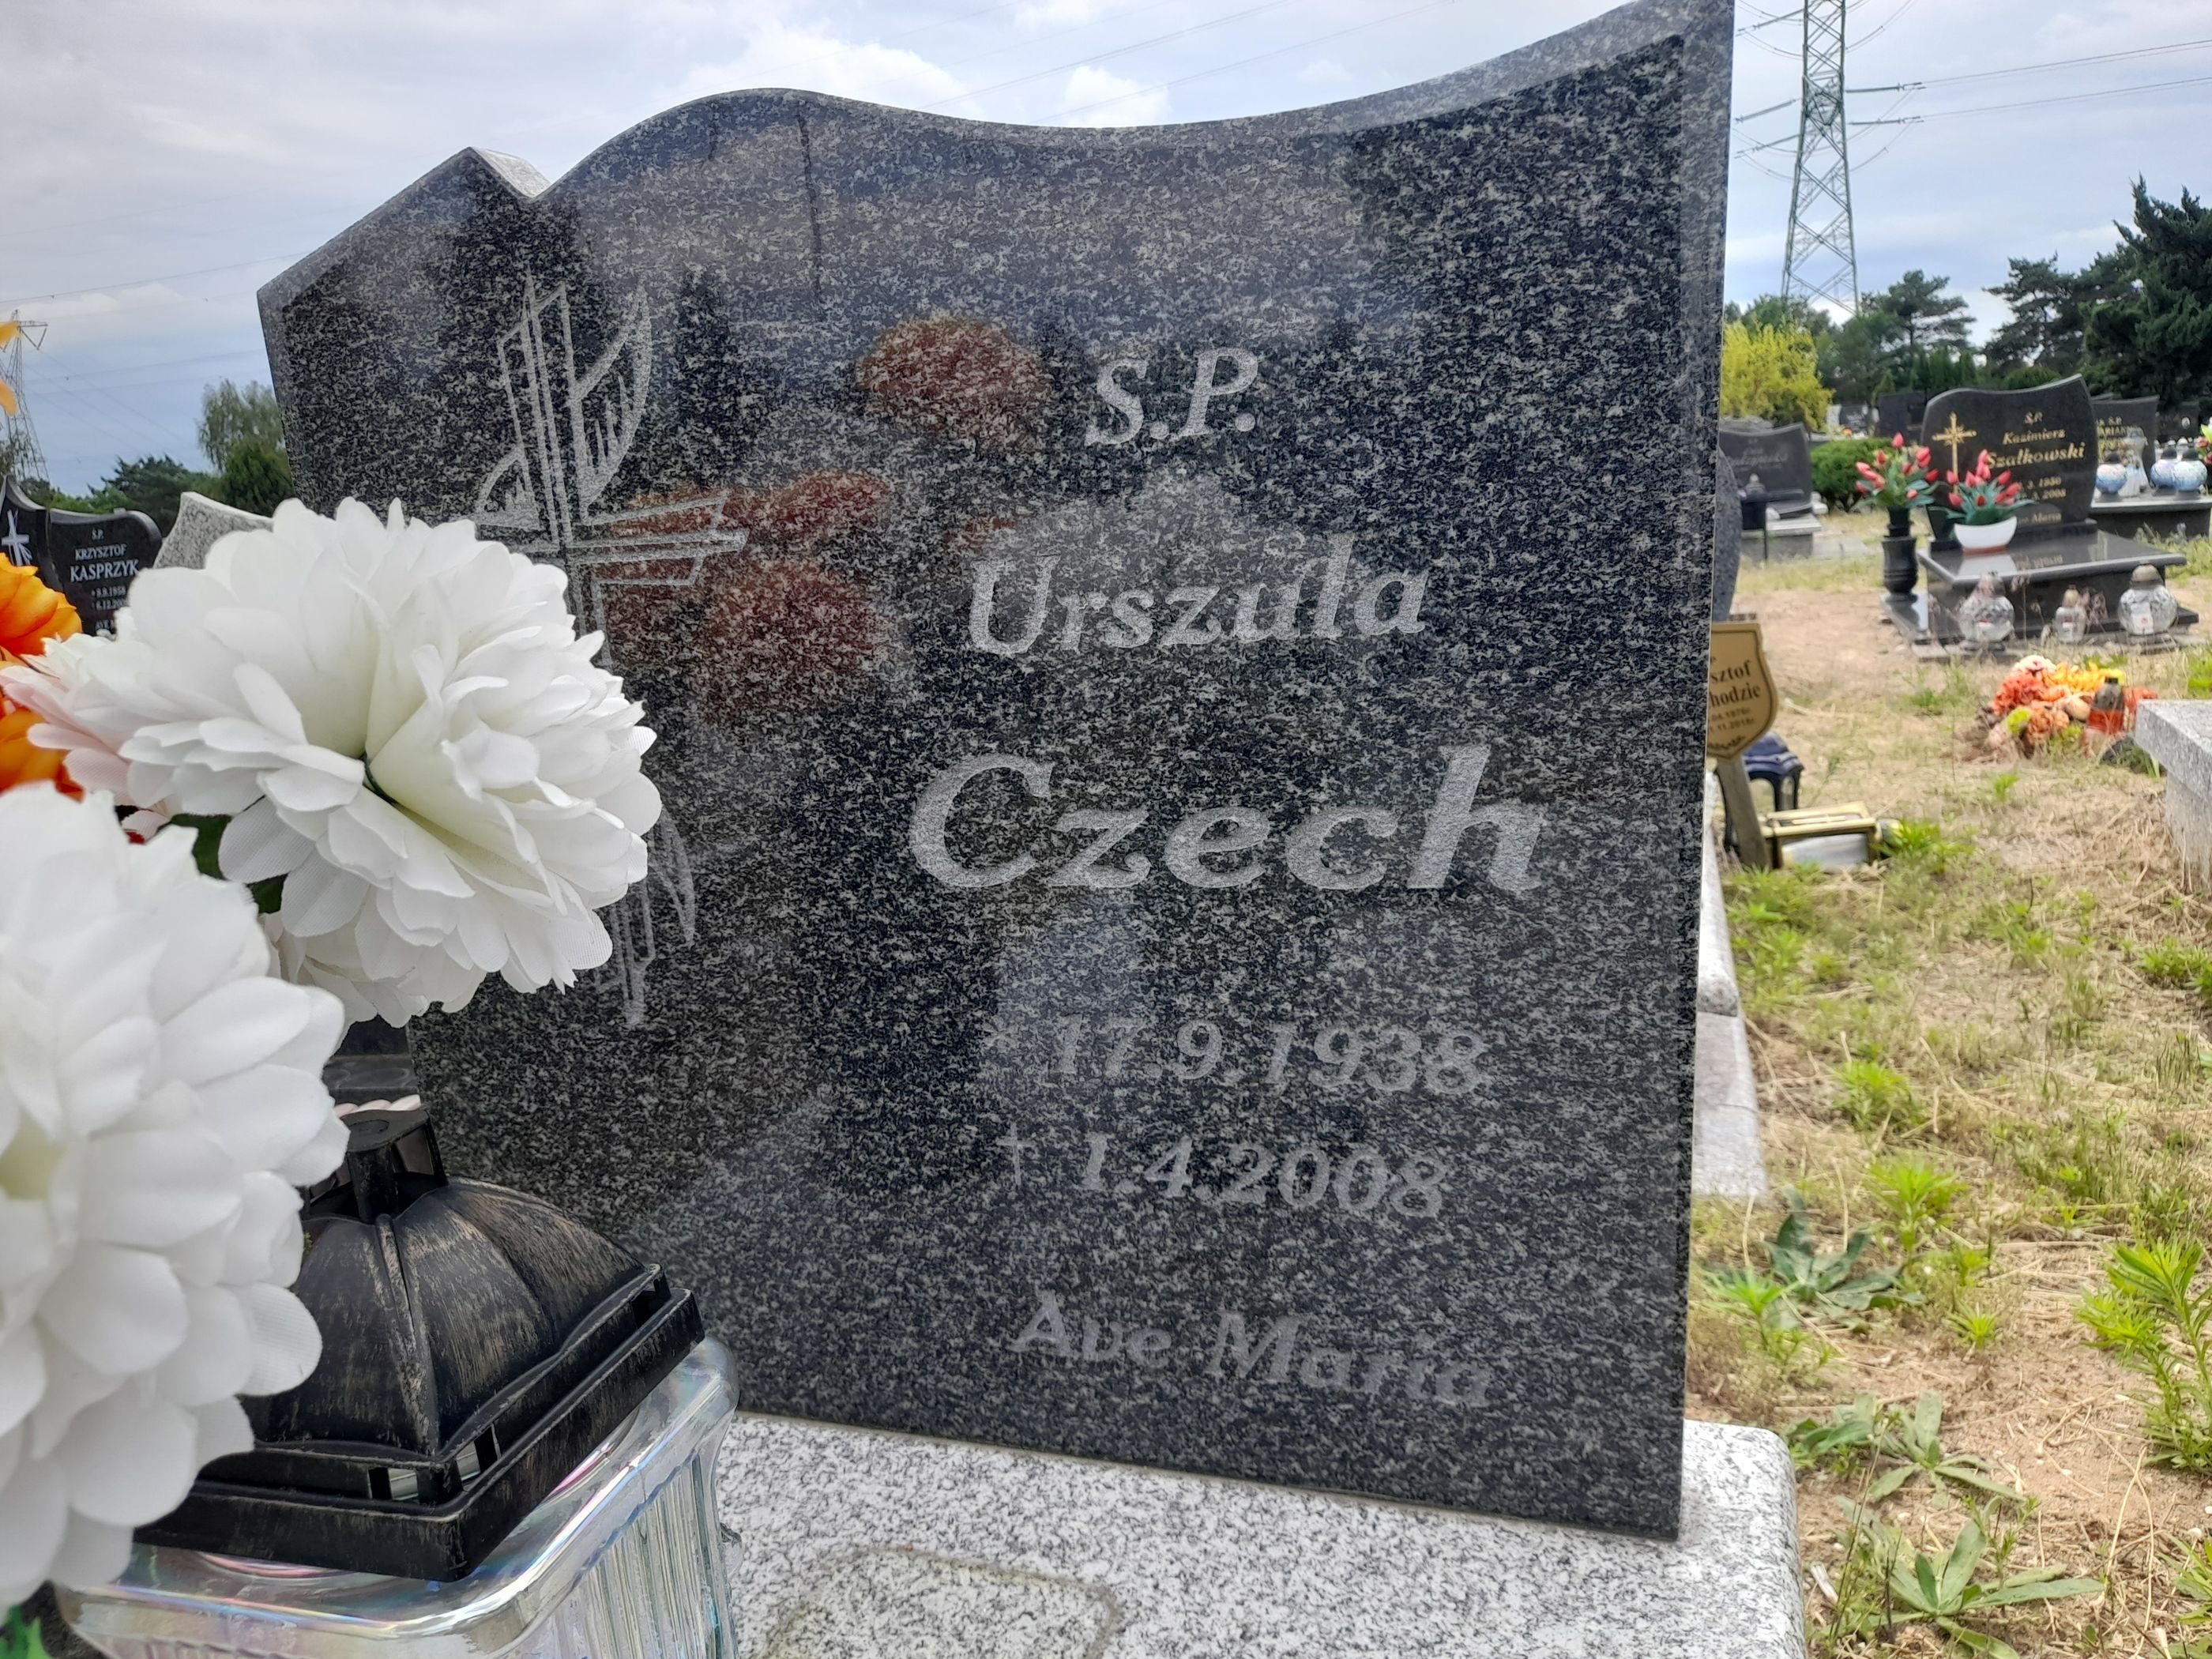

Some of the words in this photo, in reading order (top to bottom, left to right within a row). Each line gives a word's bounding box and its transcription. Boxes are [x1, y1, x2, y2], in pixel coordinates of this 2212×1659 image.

[70, 559, 139, 582] KASPRZYK
[75, 544, 127, 561] KRZYSZTOF
[970, 533, 1428, 656] Urszula
[1709, 682, 1762, 708] hodzie
[1710, 659, 1751, 684] sztof
[908, 745, 1548, 891] Czech
[1082, 1131, 1449, 1218] 1.4.2008
[1008, 1289, 1173, 1368] Ave
[1202, 1308, 1493, 1409] Maria
